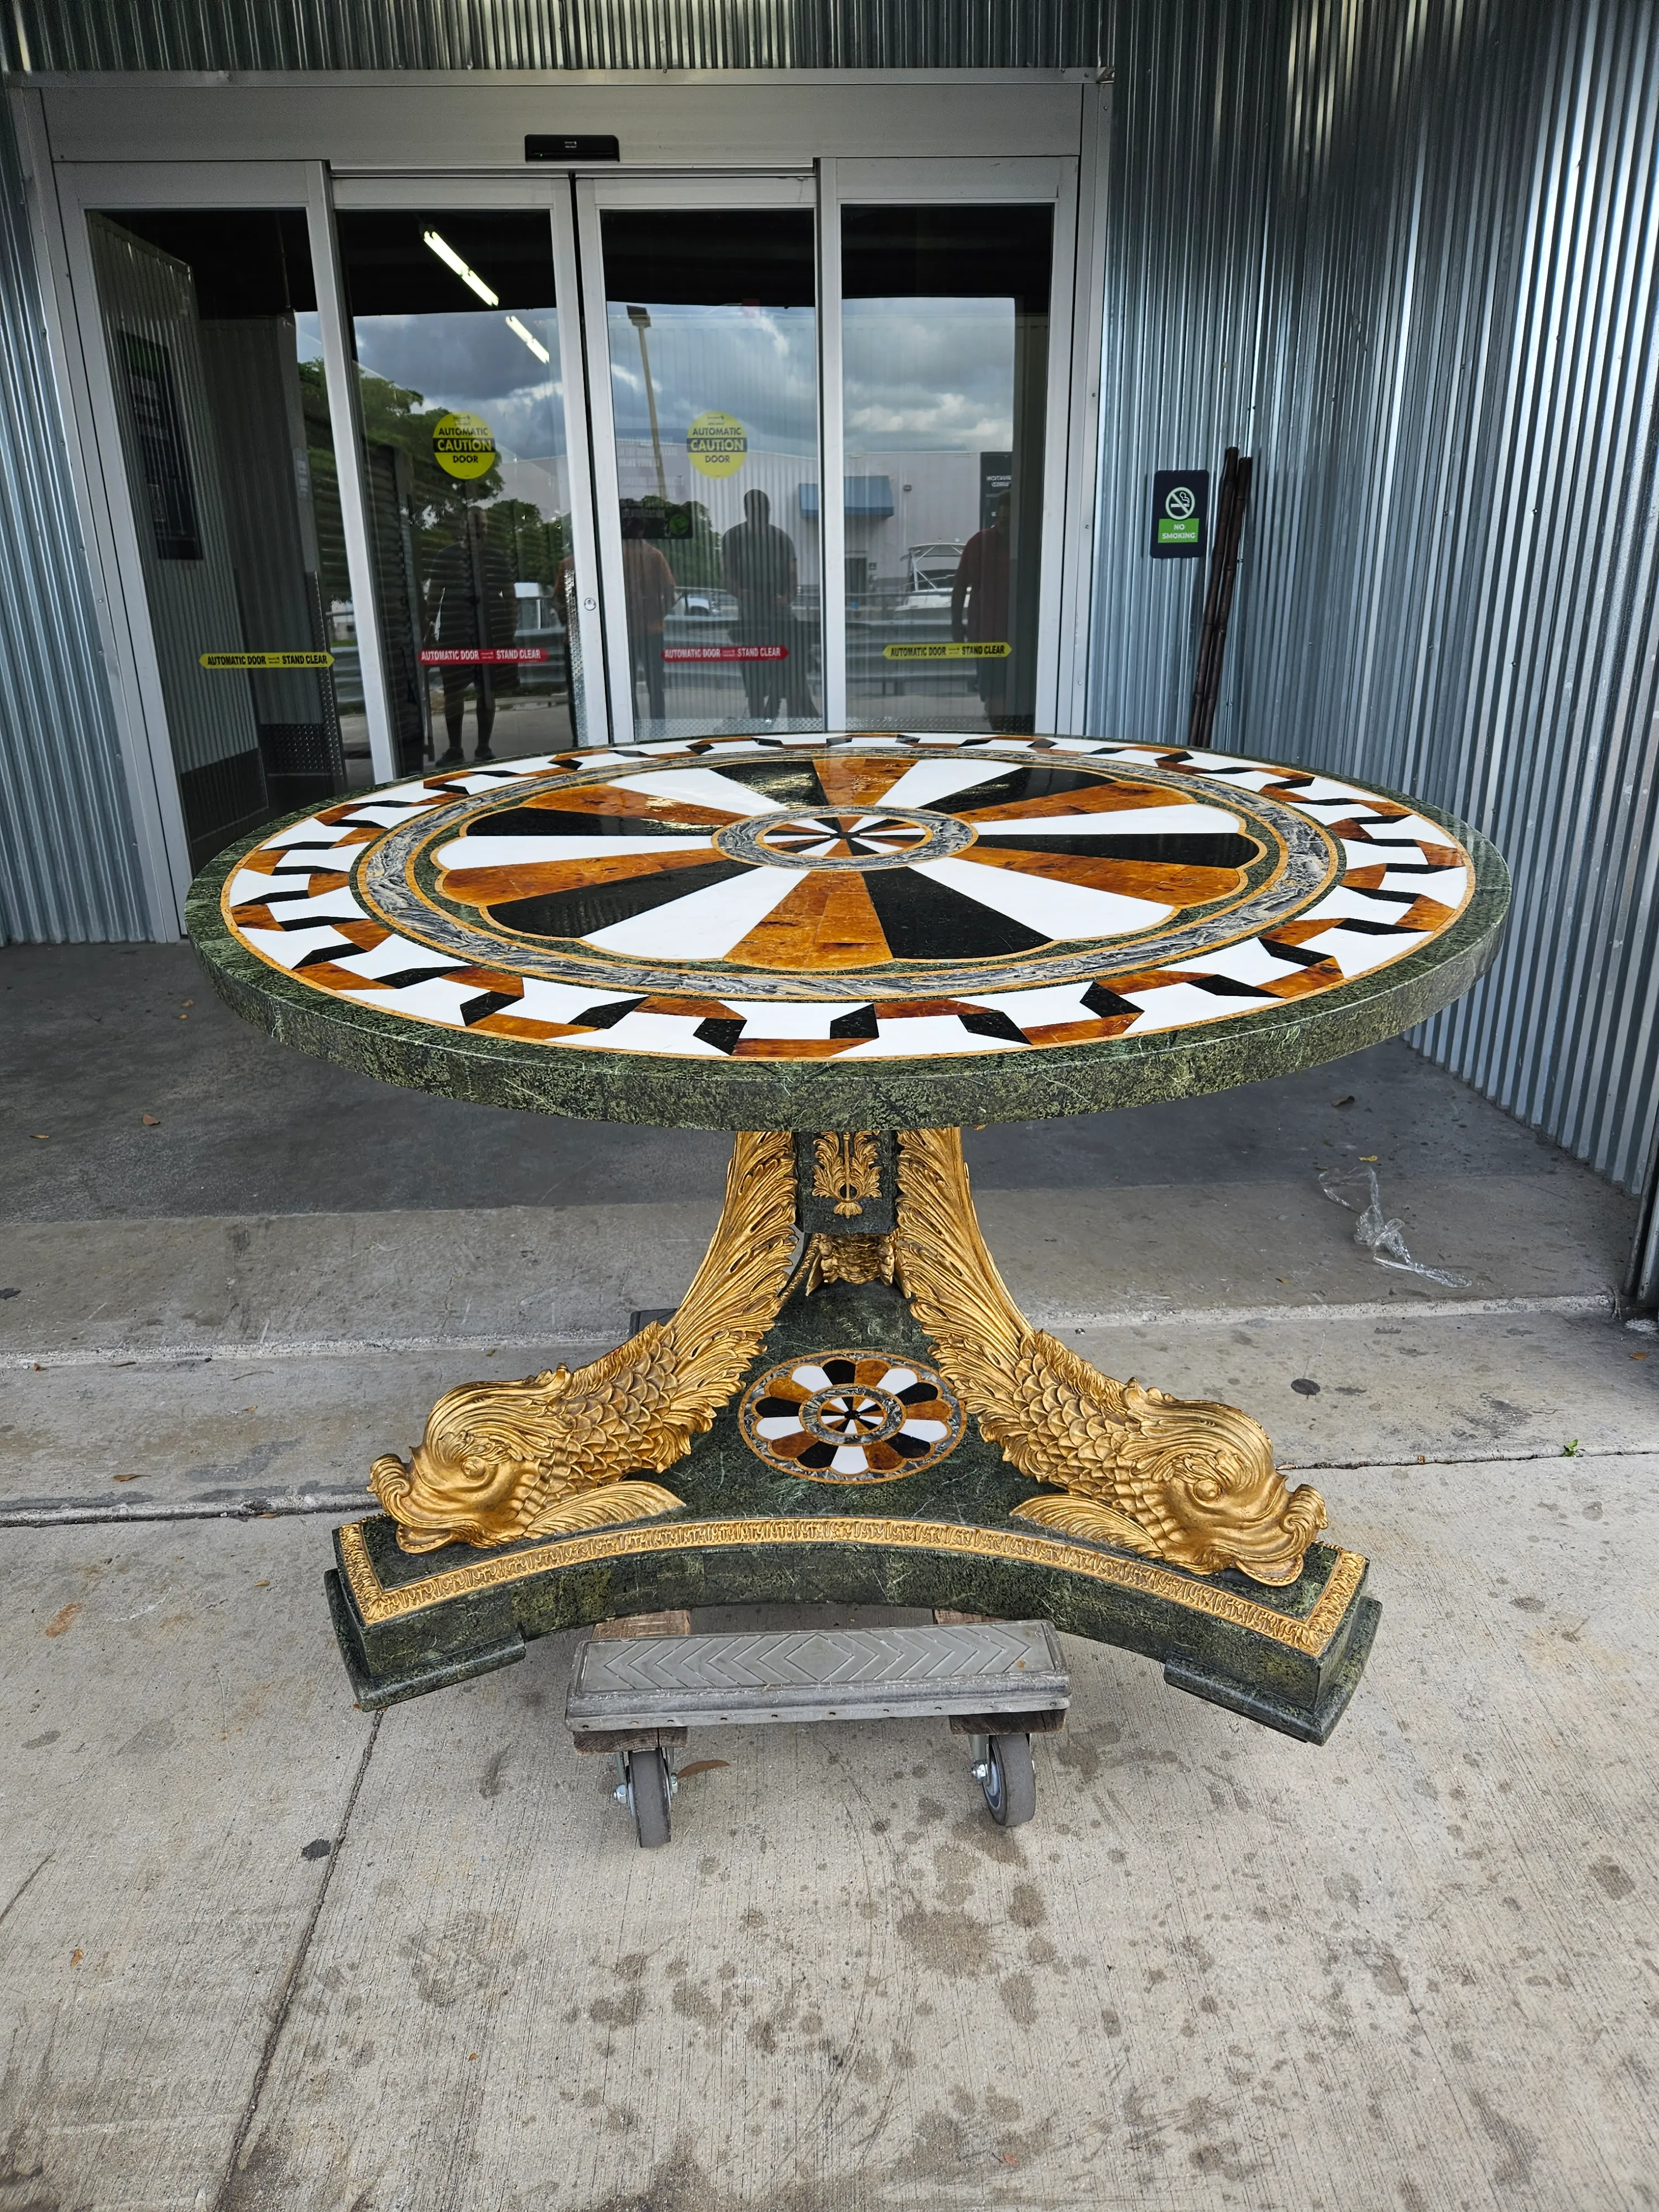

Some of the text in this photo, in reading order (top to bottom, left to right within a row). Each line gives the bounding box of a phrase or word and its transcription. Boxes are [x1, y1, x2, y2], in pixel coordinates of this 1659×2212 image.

[439, 427, 488, 436] AUTOMATIC
[692, 427, 742, 436] AUTOMATIC
[437, 439, 492, 451] CAUTION
[690, 439, 744, 451] CAUTION
[452, 455, 478, 463] DOOR
[421, 650, 460, 660] AUTOMATIC
[460, 650, 479, 660] DOOR
[496, 650, 518, 659] STAND
[519, 649, 541, 659] CLEAR
[665, 649, 702, 658] AUTOMATIC
[702, 649, 721, 658] DOOR
[737, 648, 759, 657] STAND
[760, 647, 781, 656] CLEAR
[890, 648, 927, 657] AUTOMATIC
[928, 646, 947, 656] DOOR
[962, 646, 983, 655] STAND
[984, 645, 1005, 654] CLEAR
[207, 656, 247, 665] AUTOMATIC
[247, 656, 267, 665] DOOR
[282, 655, 304, 664] STAND
[305, 655, 328, 664] CLEAR
